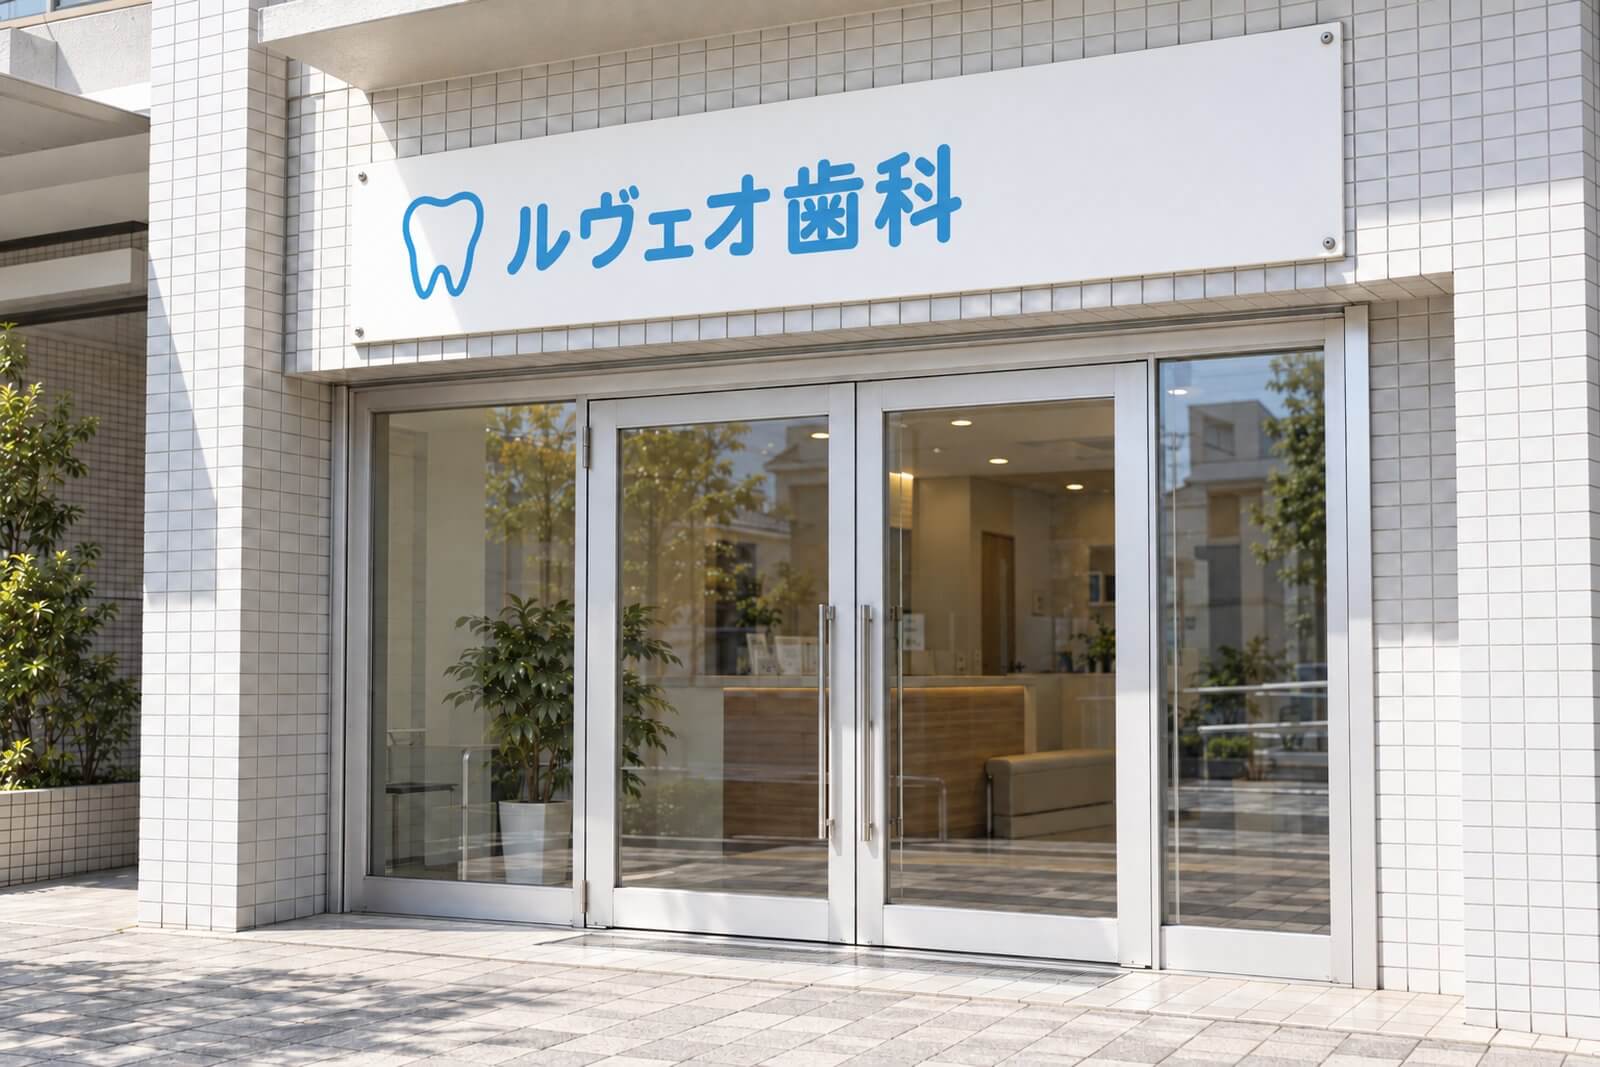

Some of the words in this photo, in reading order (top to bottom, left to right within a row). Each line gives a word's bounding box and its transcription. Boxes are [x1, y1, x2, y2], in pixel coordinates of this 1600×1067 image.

[507, 143, 962, 275] ルヴェオ歯科
